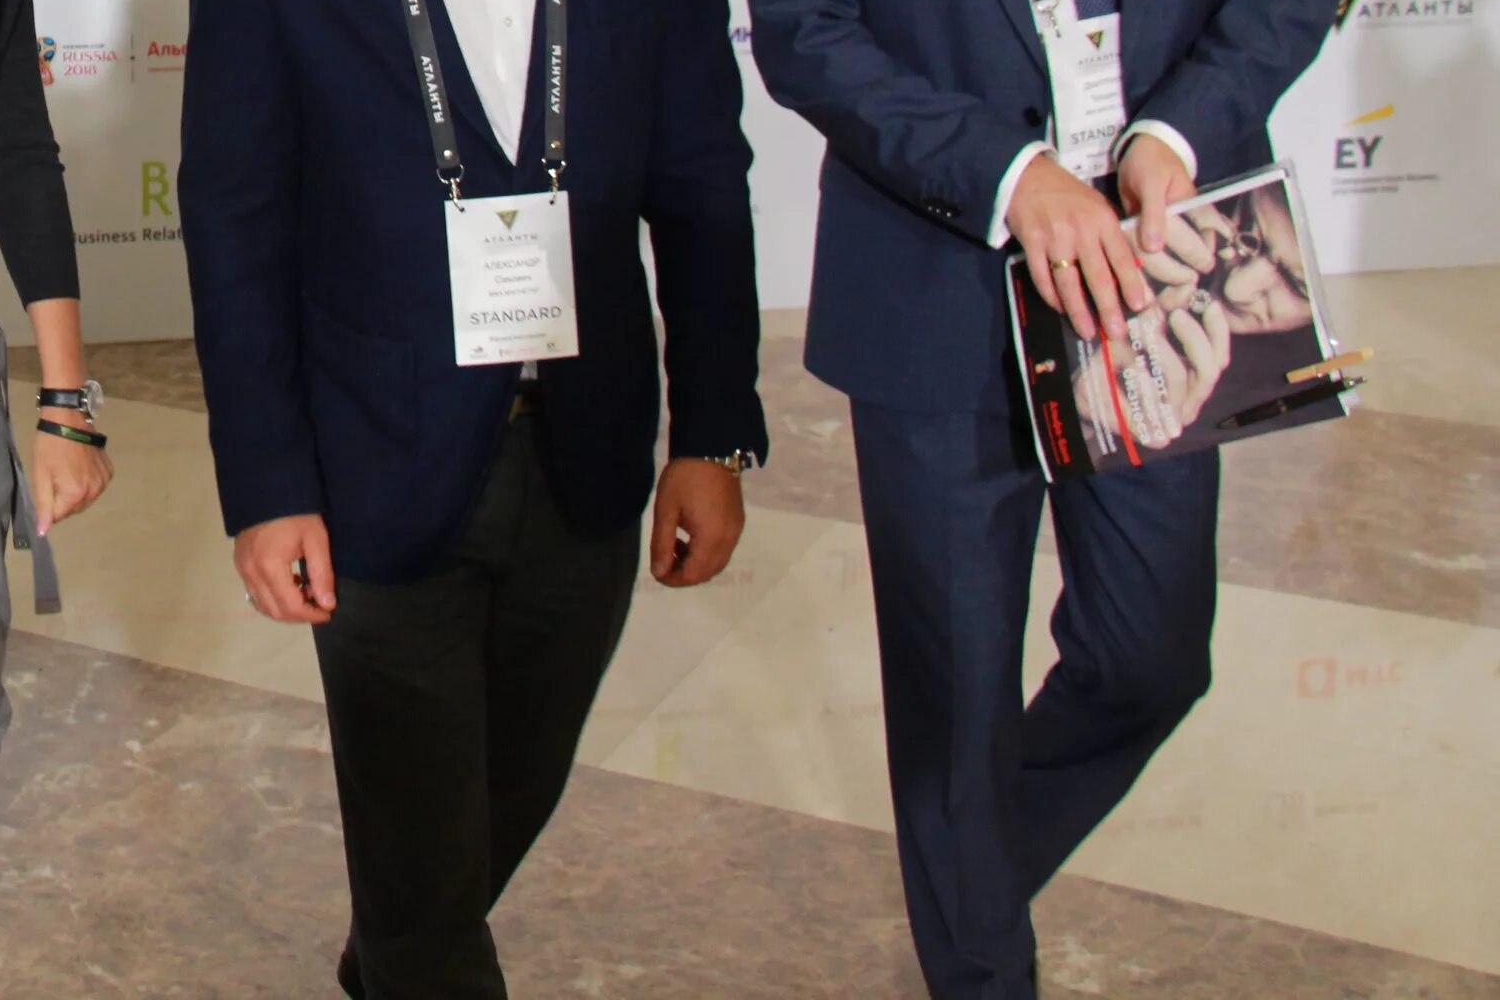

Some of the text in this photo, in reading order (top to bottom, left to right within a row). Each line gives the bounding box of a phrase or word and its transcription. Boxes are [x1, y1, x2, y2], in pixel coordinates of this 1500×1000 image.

[1358, 0, 1474, 17] АТЛАНТЫ
[420, 55, 445, 124] АТЛАНТЫ
[550, 45, 562, 114] АТЛАНТЫ
[1333, 135, 1383, 169] EY
[75, 229, 137, 245] usiness
[469, 305, 562, 326] STANDARD
